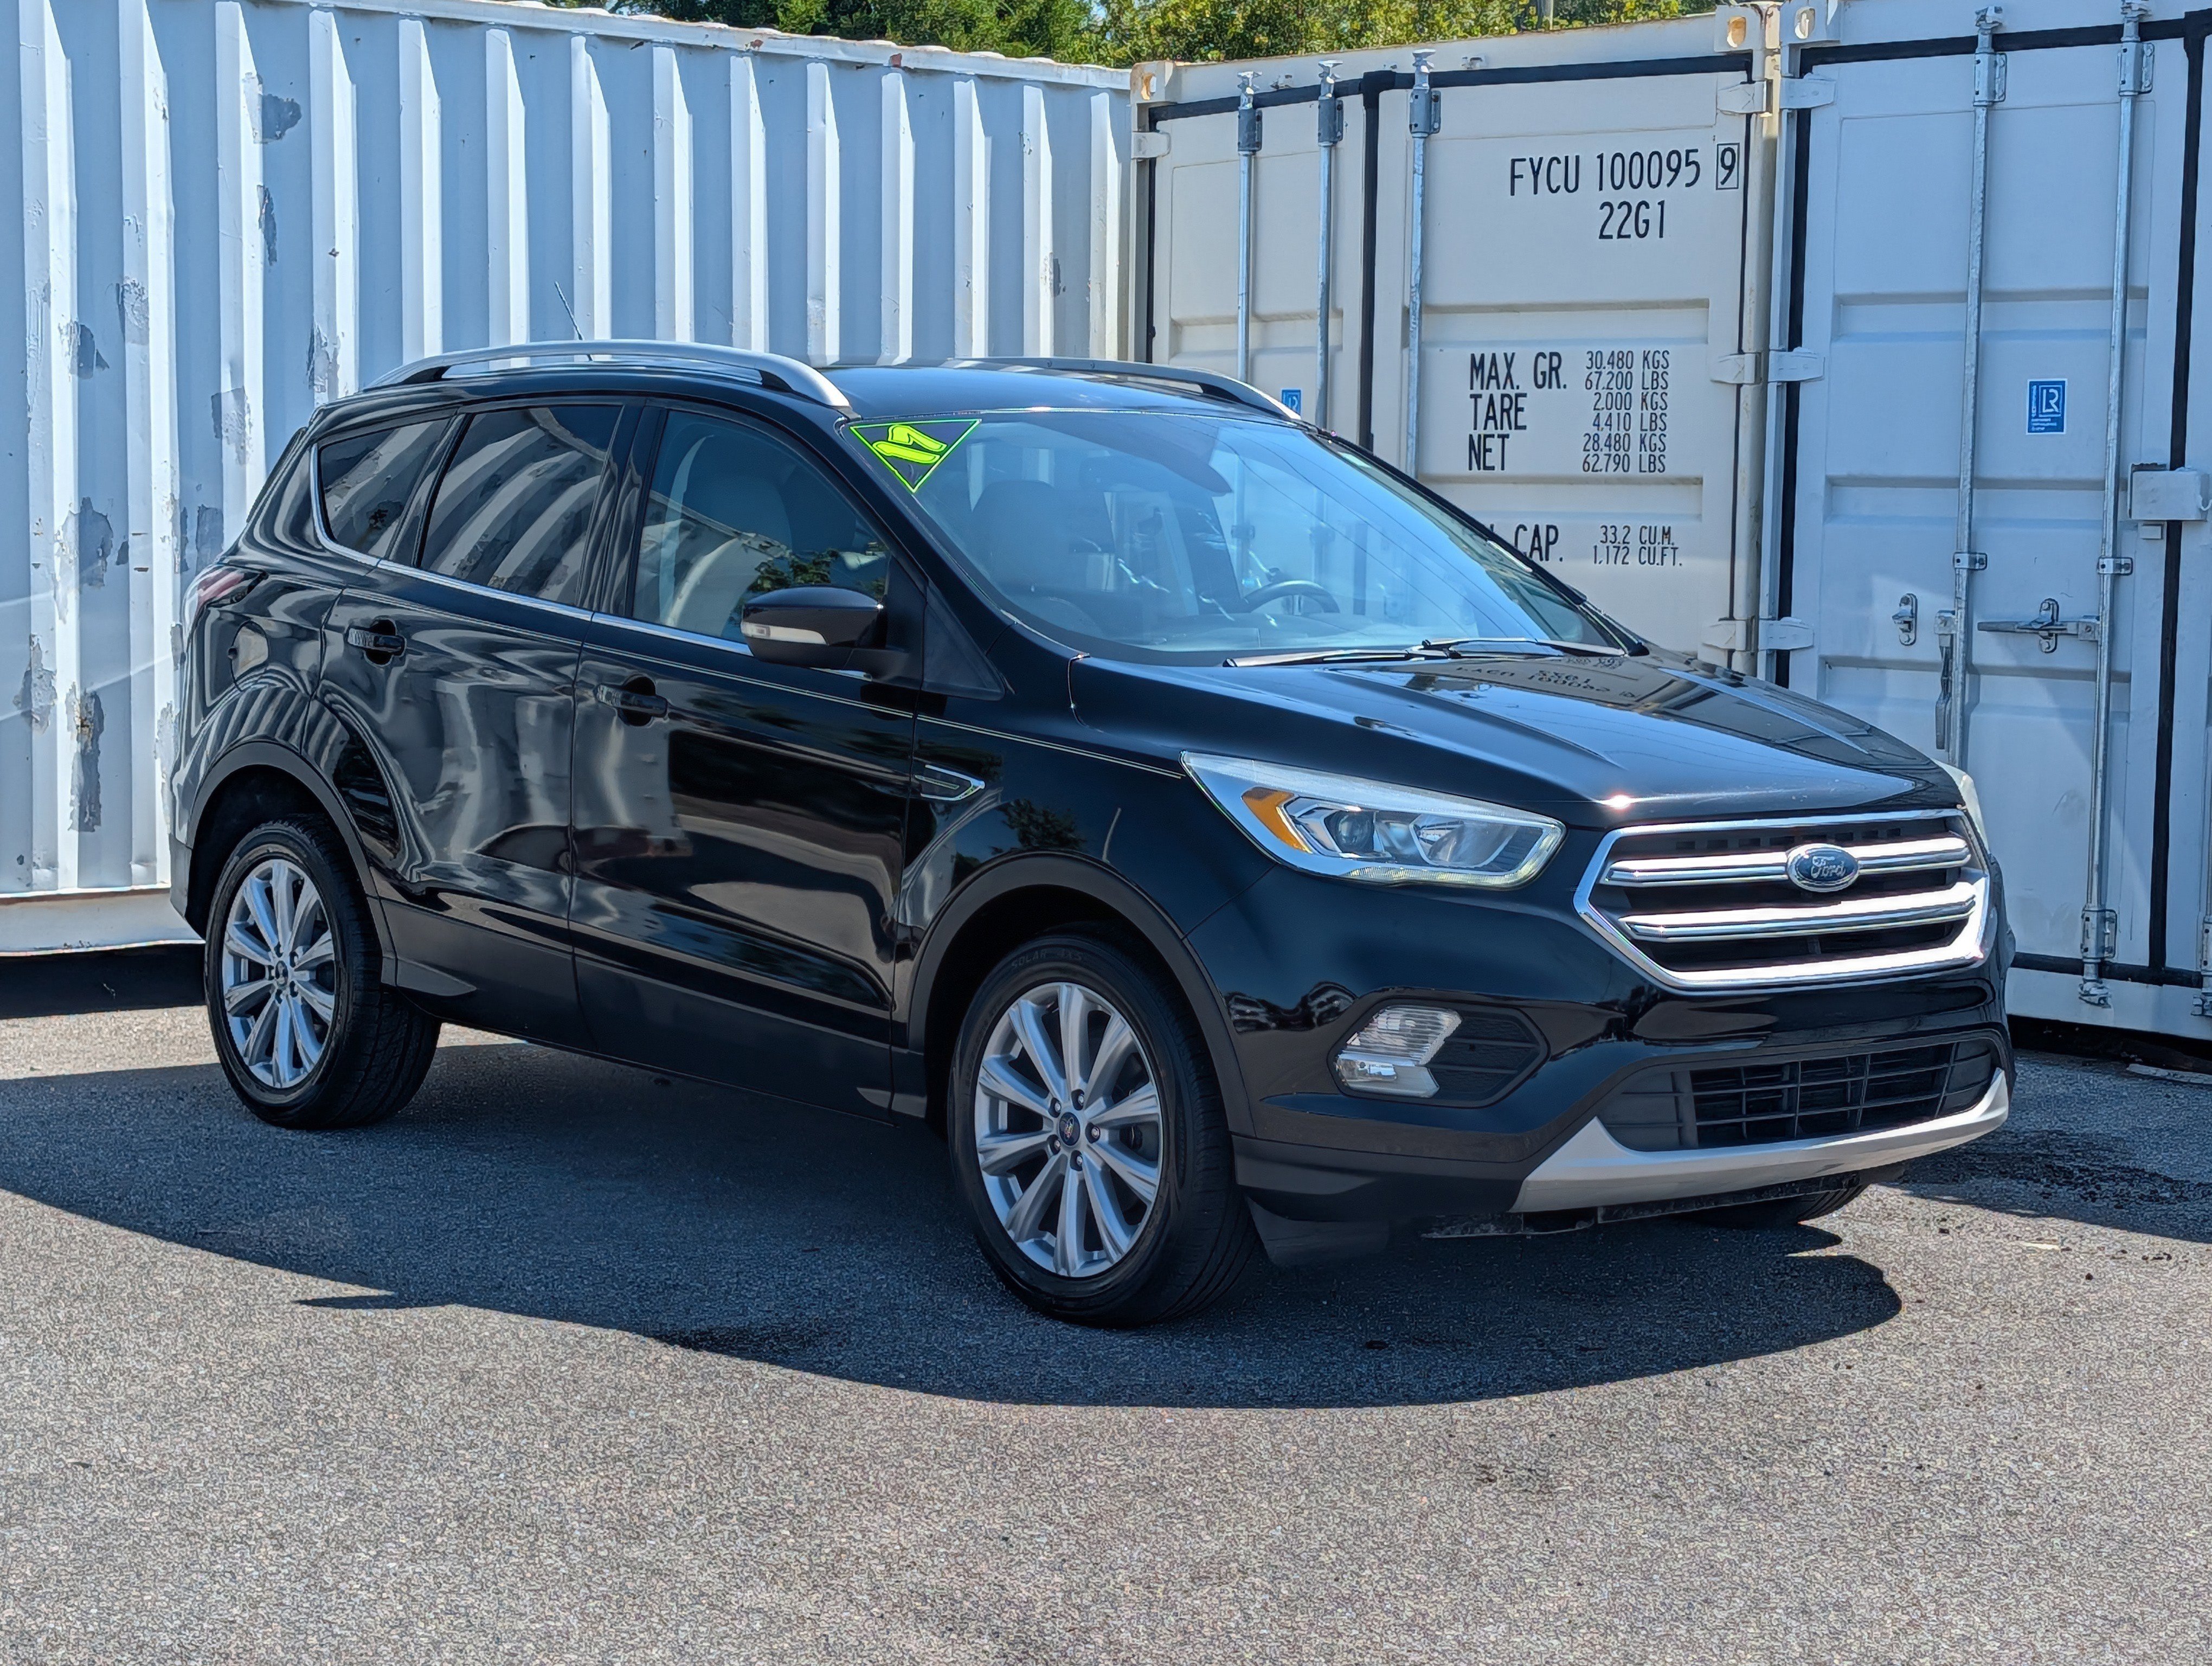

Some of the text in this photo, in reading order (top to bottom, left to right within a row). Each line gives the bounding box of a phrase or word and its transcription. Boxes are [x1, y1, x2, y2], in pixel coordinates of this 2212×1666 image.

[1510, 146, 1736, 196] FYCU 100095 9
[1598, 200, 1665, 240] 22G1
[1470, 351, 1567, 390] MAX. GR.
[1642, 350, 1670, 370] KGS
[1642, 370, 1669, 390] LBS
[1641, 391, 1668, 411] KGS
[1469, 393, 1528, 431] TARE
[1639, 412, 1667, 432] LBS
[872, 424, 947, 464] 17
[1468, 433, 1510, 471] NET
[1639, 433, 1667, 453] KGS
[1638, 453, 1666, 473] LBS
[1514, 524, 1564, 562] CAP.
[1600, 525, 1675, 546] 33.2 CU.M.
[1638, 546, 1682, 566] CU.FT.
[1810, 856, 1846, 878] Ford
